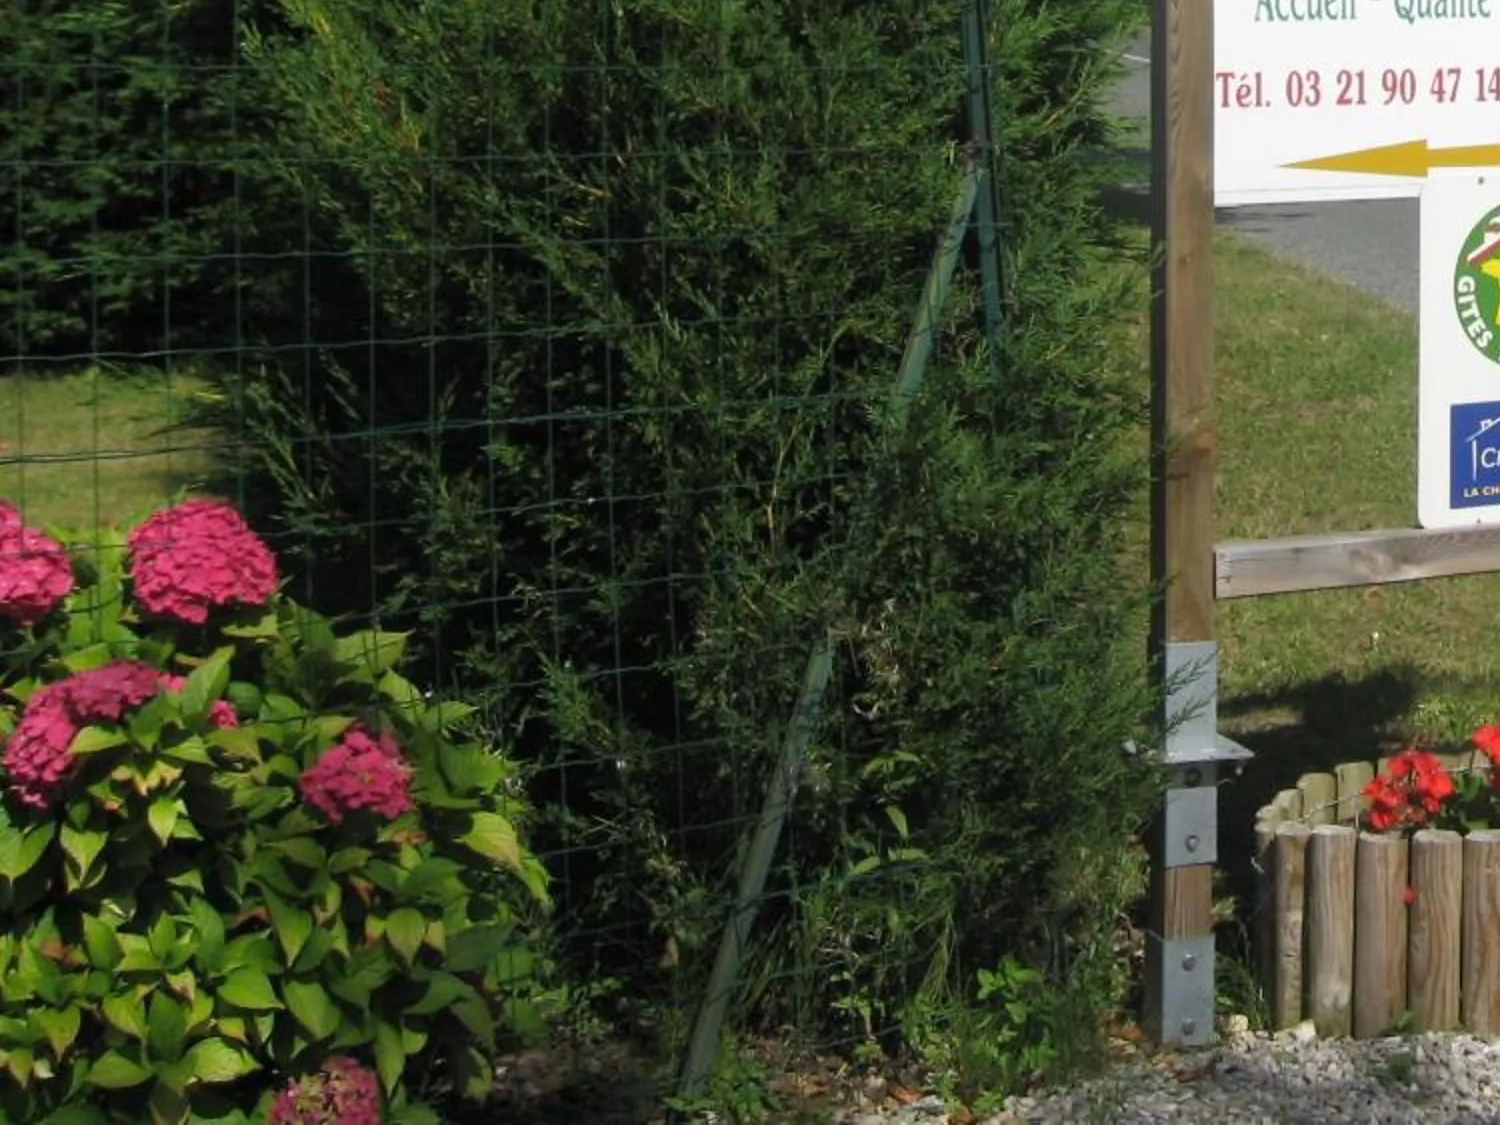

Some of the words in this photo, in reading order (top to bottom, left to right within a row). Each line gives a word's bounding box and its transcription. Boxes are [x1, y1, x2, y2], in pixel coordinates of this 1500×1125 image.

[1216, 71, 1271, 108] Tél.
[1285, 70, 1321, 107] 03
[1335, 69, 1367, 106] 21
[1381, 68, 1417, 105] 90
[1430, 67, 1462, 103] 47
[1463, 487, 1479, 498] LA
